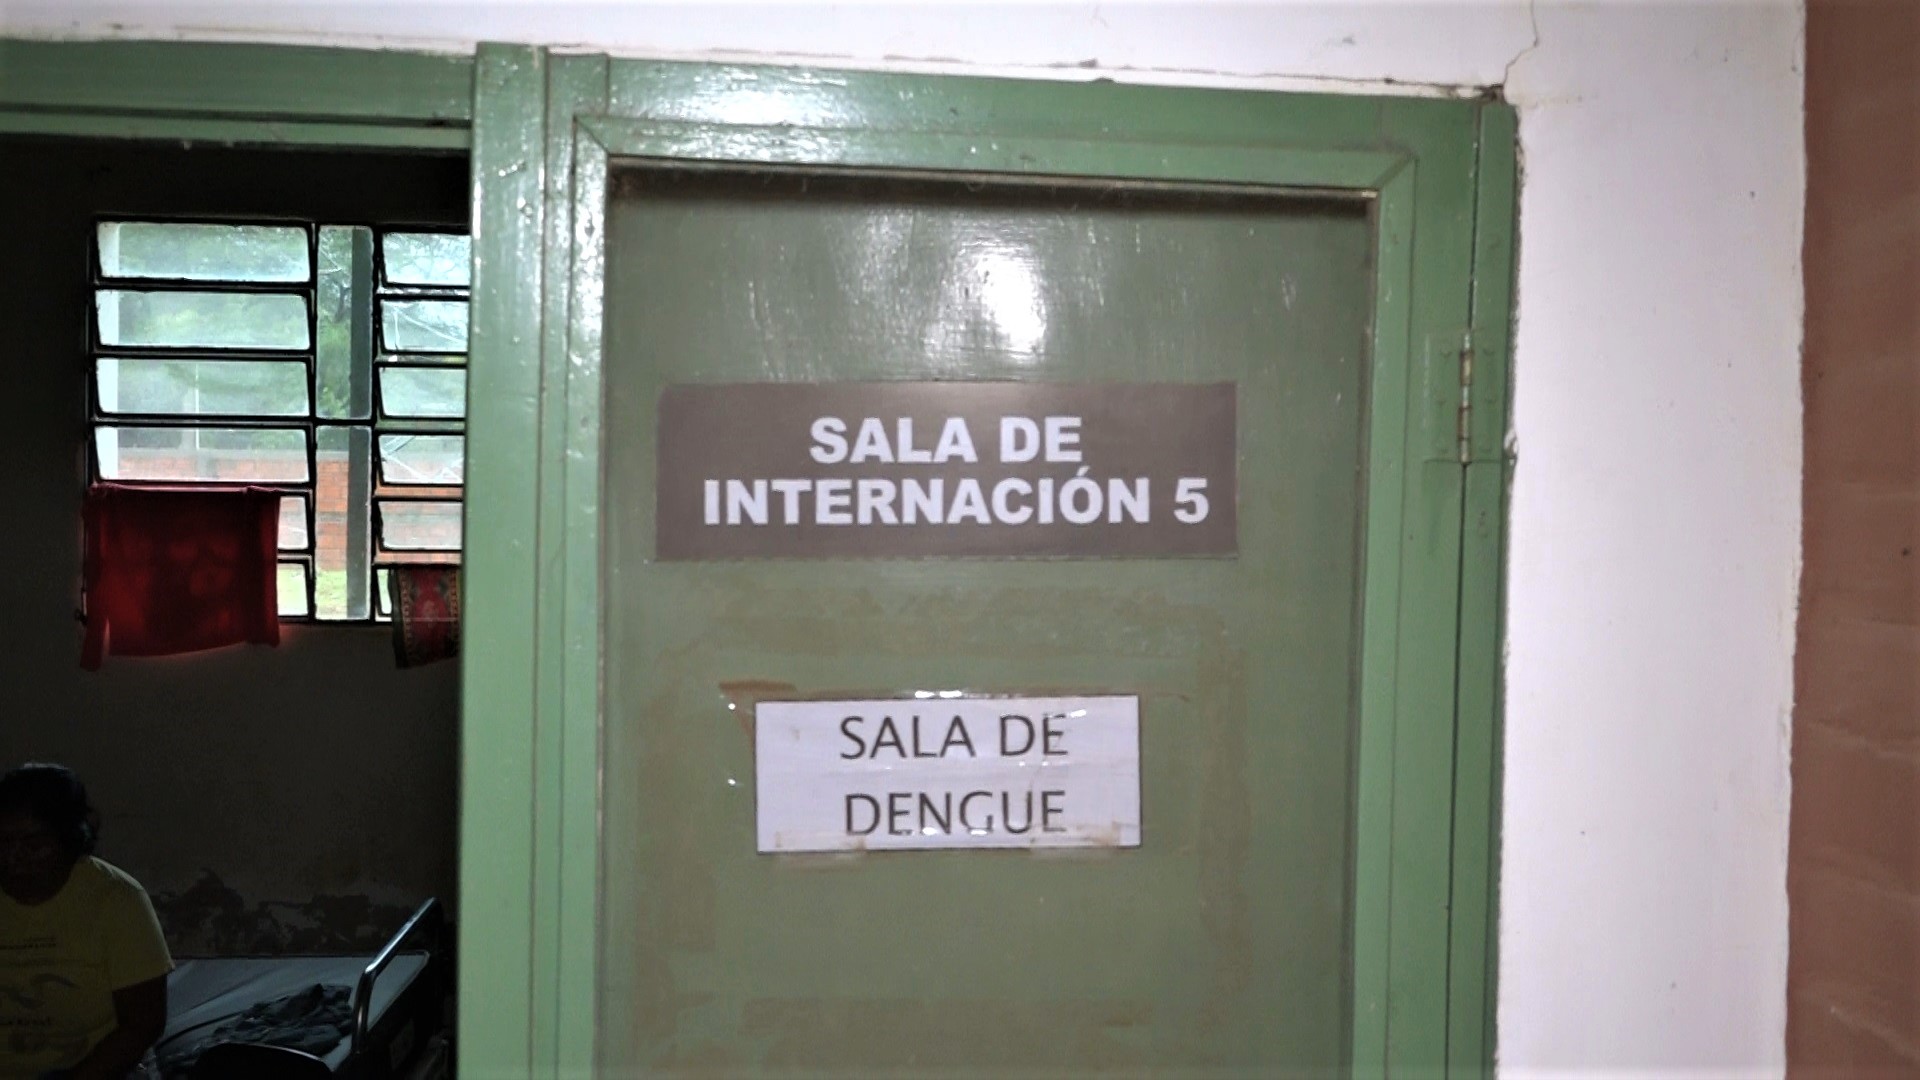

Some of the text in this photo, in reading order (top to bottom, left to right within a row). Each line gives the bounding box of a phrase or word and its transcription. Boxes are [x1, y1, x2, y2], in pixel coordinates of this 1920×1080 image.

[811, 417, 1082, 464] SALA DE
[705, 466, 1209, 525] INTERNACIÓN 5
[840, 714, 1069, 760] SALA DE
[846, 790, 1066, 836] DENGUE
